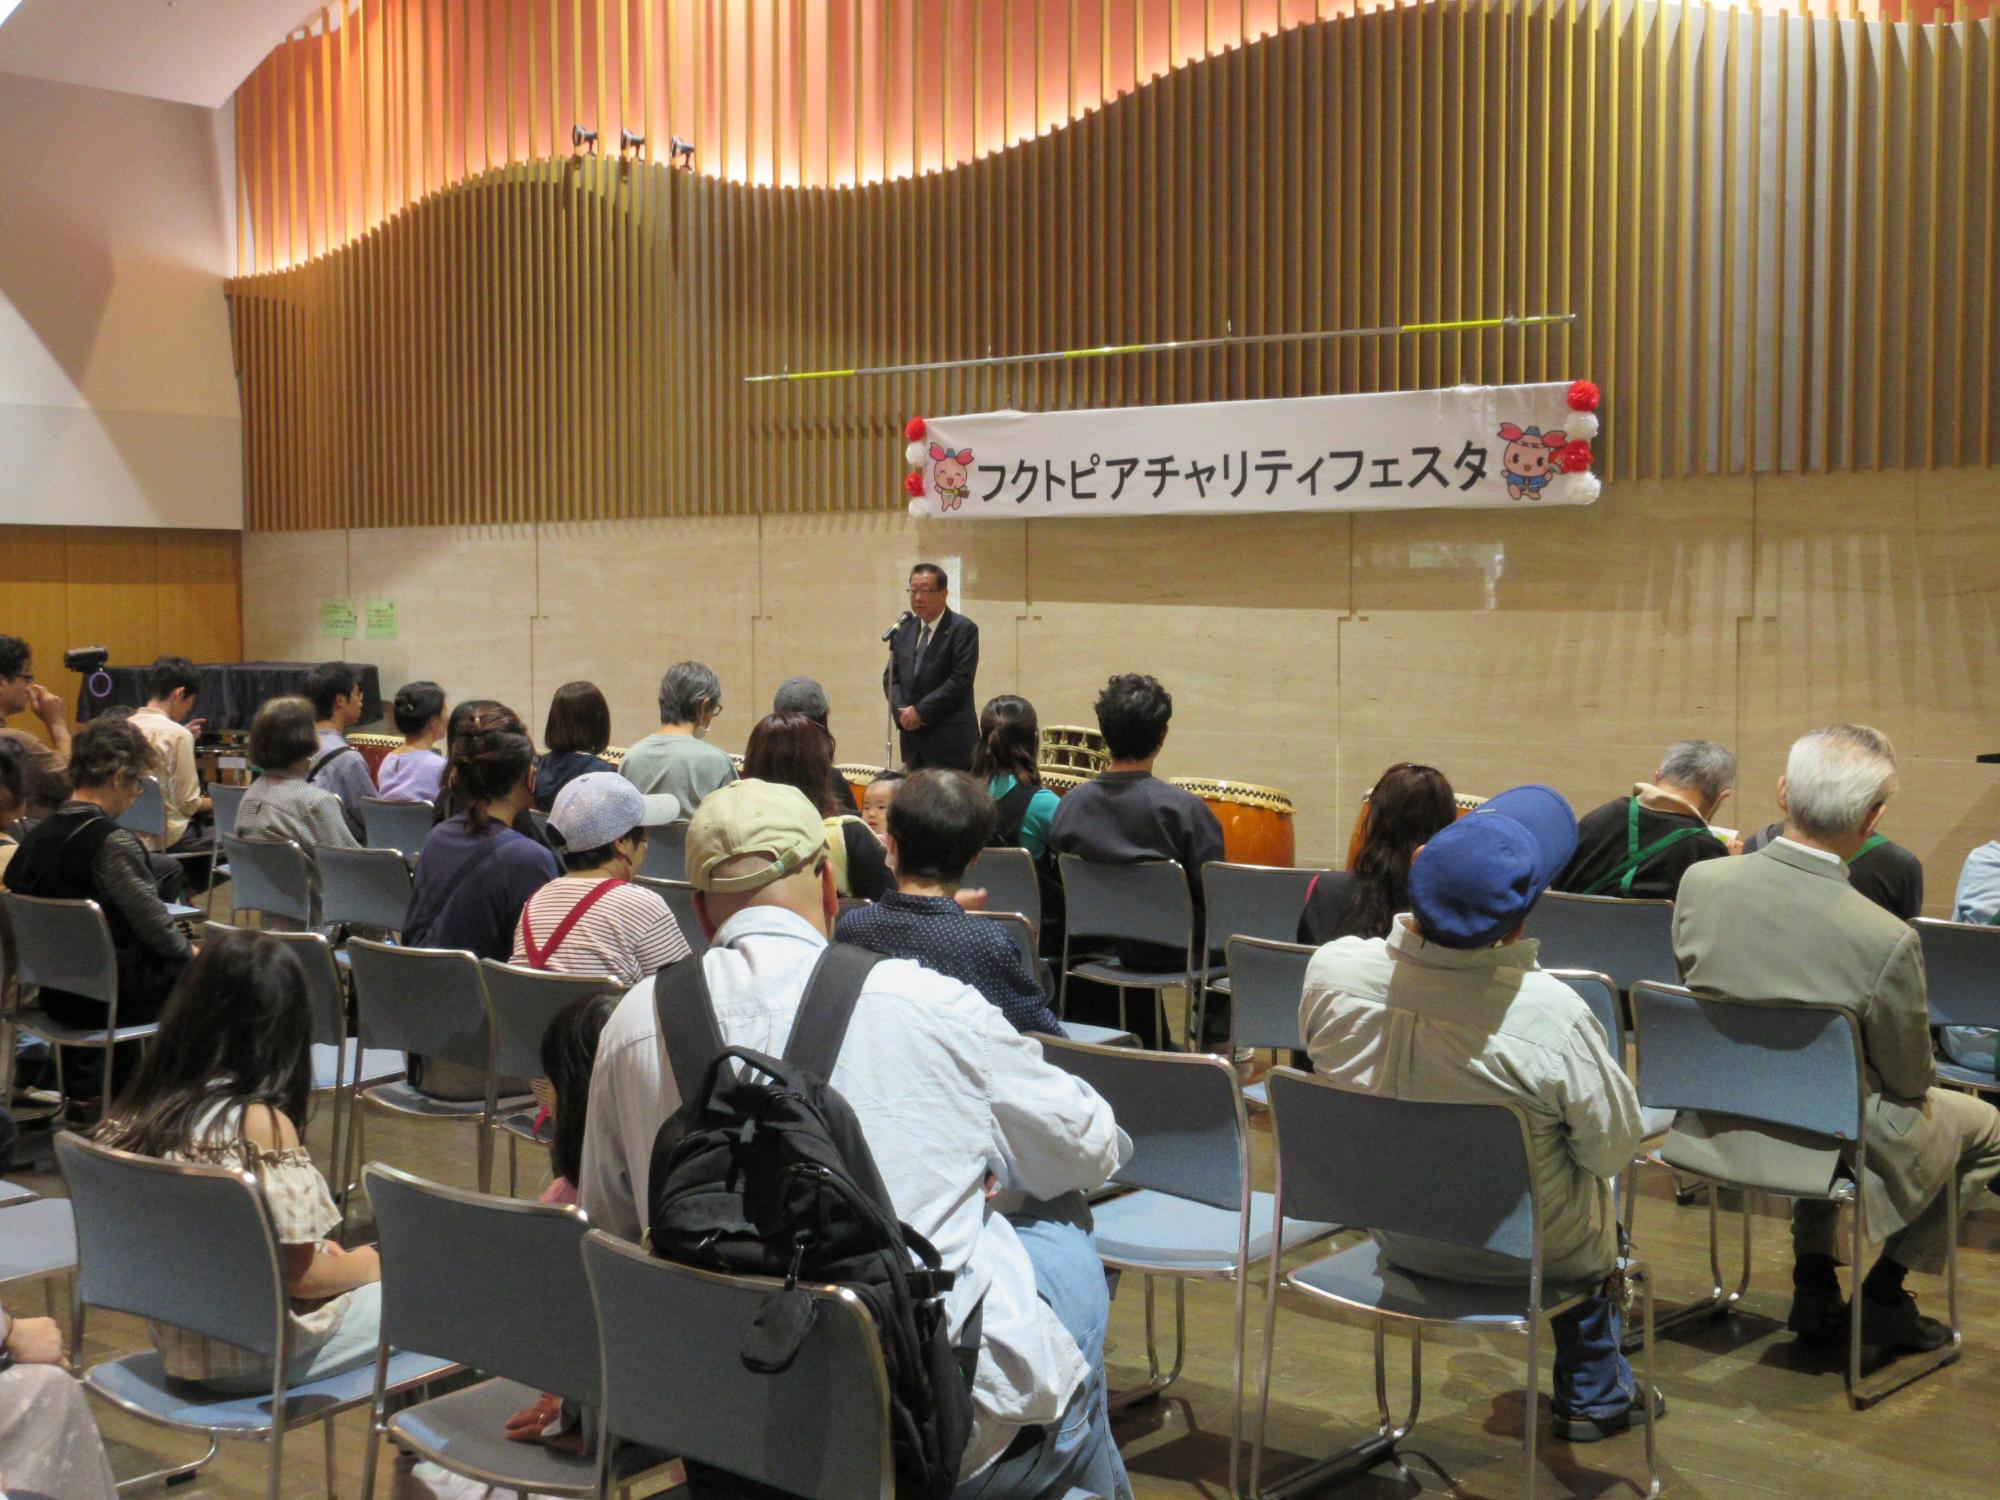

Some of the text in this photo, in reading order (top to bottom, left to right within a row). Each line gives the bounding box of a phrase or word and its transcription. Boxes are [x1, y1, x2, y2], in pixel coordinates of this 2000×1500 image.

[978, 440, 1487, 503] フクトピアチャリティフェスタ
